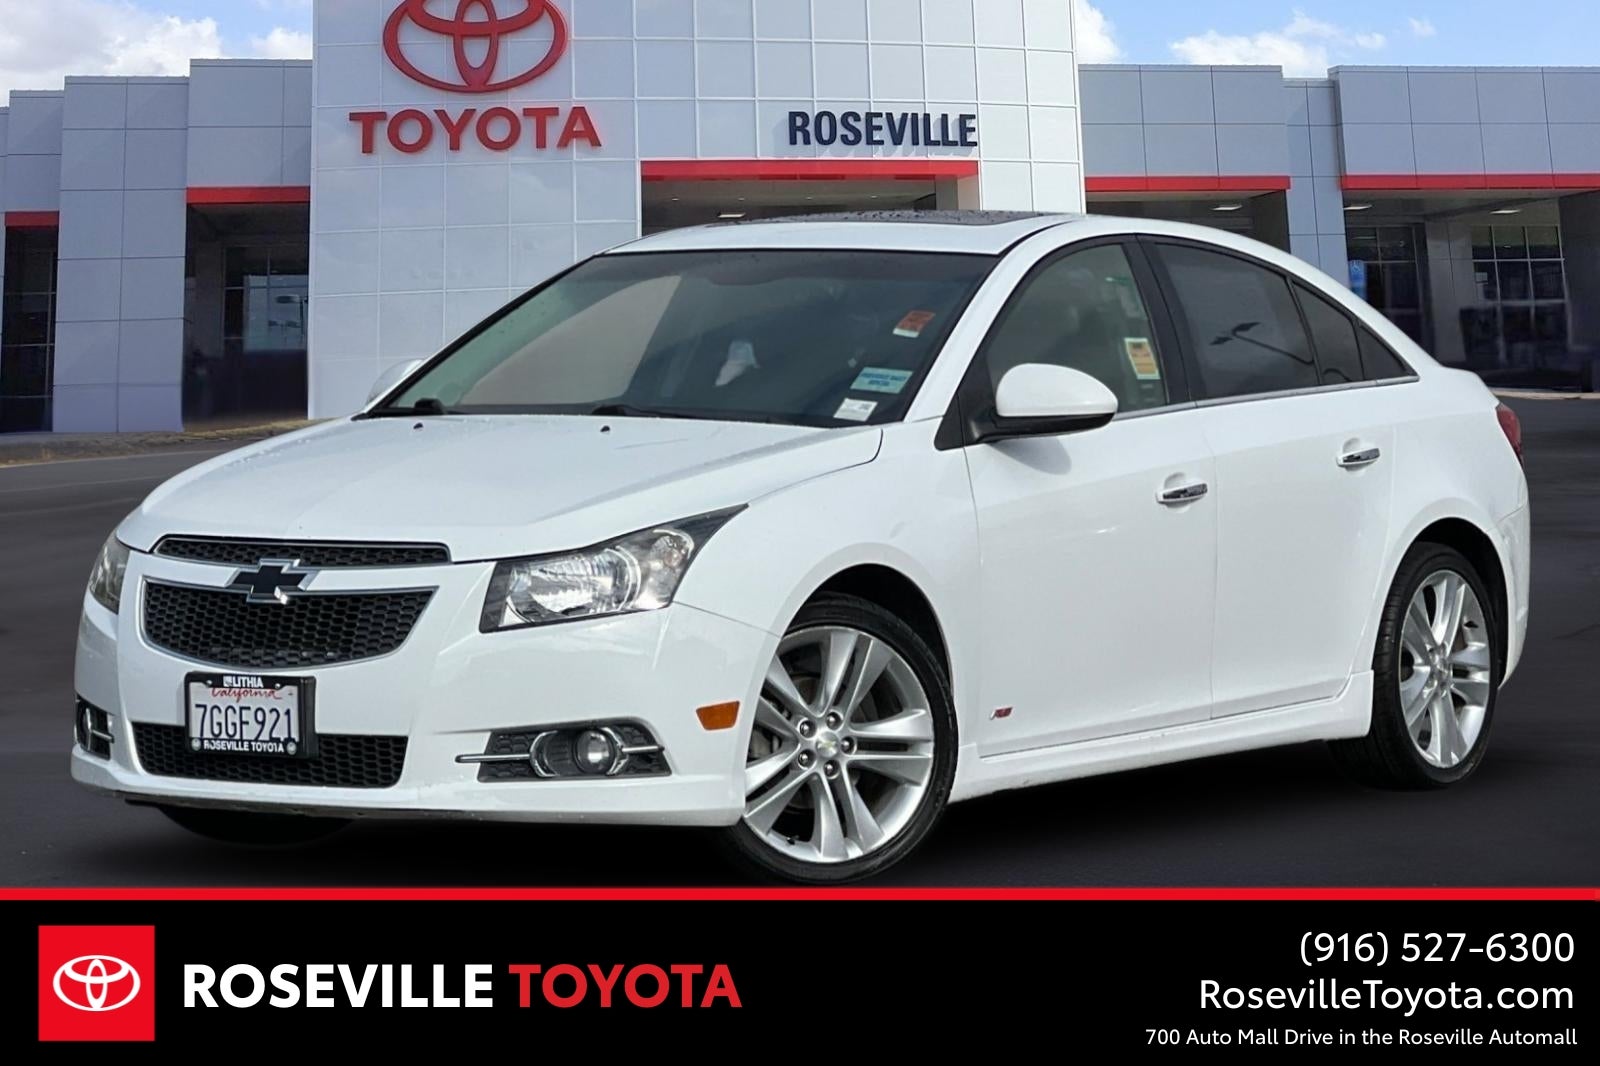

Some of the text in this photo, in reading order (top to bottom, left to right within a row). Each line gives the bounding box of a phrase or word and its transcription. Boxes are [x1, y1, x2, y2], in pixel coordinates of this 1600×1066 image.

[349, 106, 602, 154] TOYOTA
[788, 110, 978, 148] ROSEVILLE
[232, 676, 264, 688] LITHIA
[195, 704, 294, 741] 7GGF921
[203, 739, 285, 752] ROSEVILLE TOYOTA
